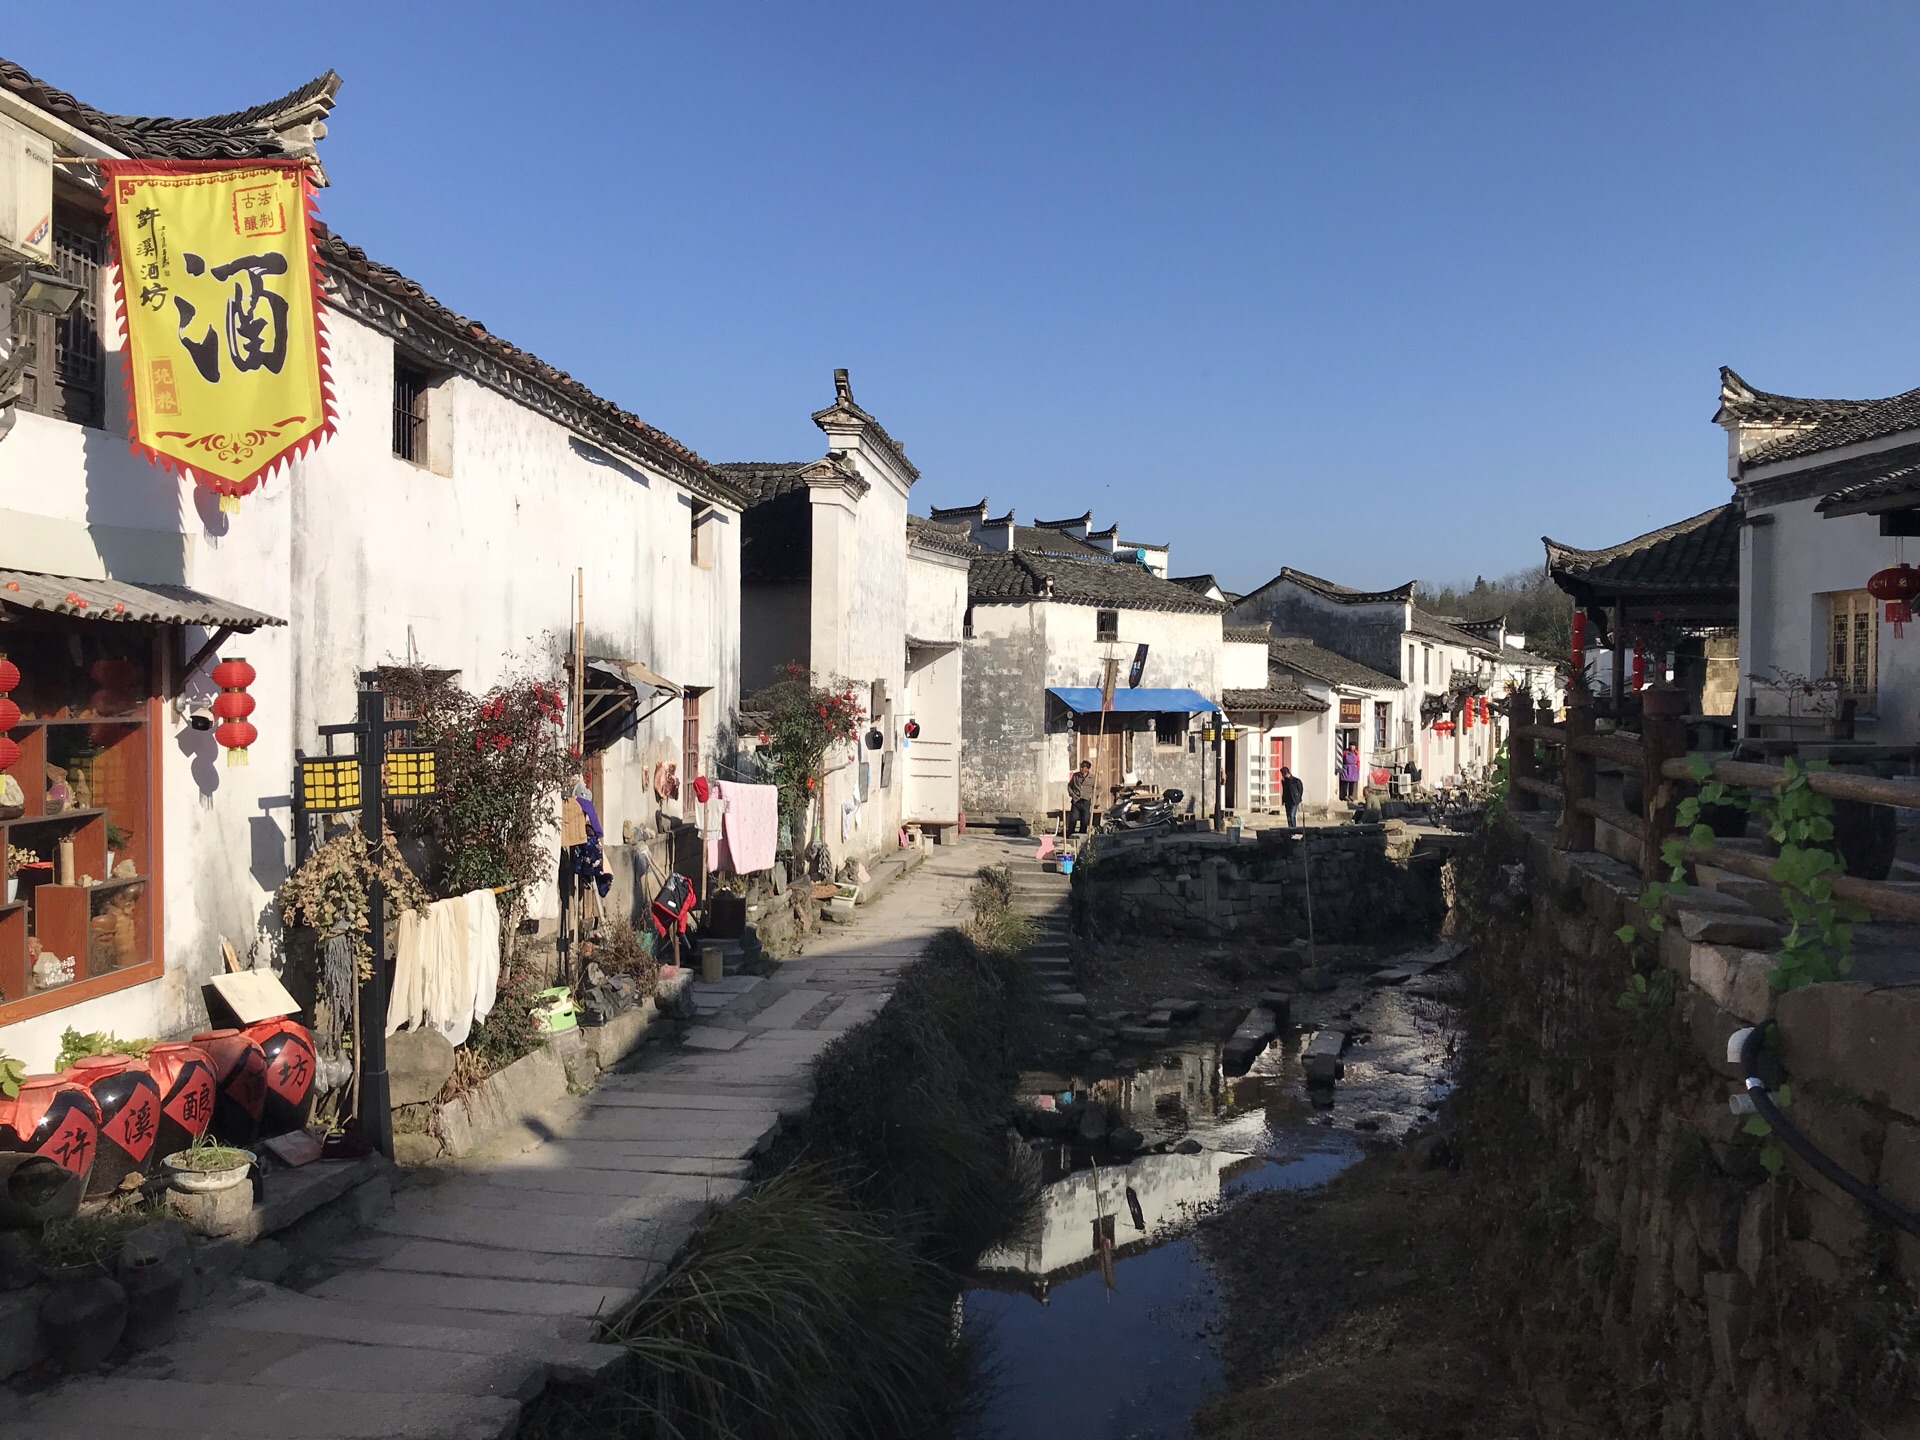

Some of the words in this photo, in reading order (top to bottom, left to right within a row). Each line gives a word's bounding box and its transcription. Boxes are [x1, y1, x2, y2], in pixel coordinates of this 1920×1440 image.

[32, 152, 50, 167] GREE
[241, 190, 271, 209] 古法
[173, 251, 289, 383] 酒
[278, 1054, 309, 1087] 坊
[124, 1100, 155, 1145] 溪
[52, 1127, 91, 1173] 许
